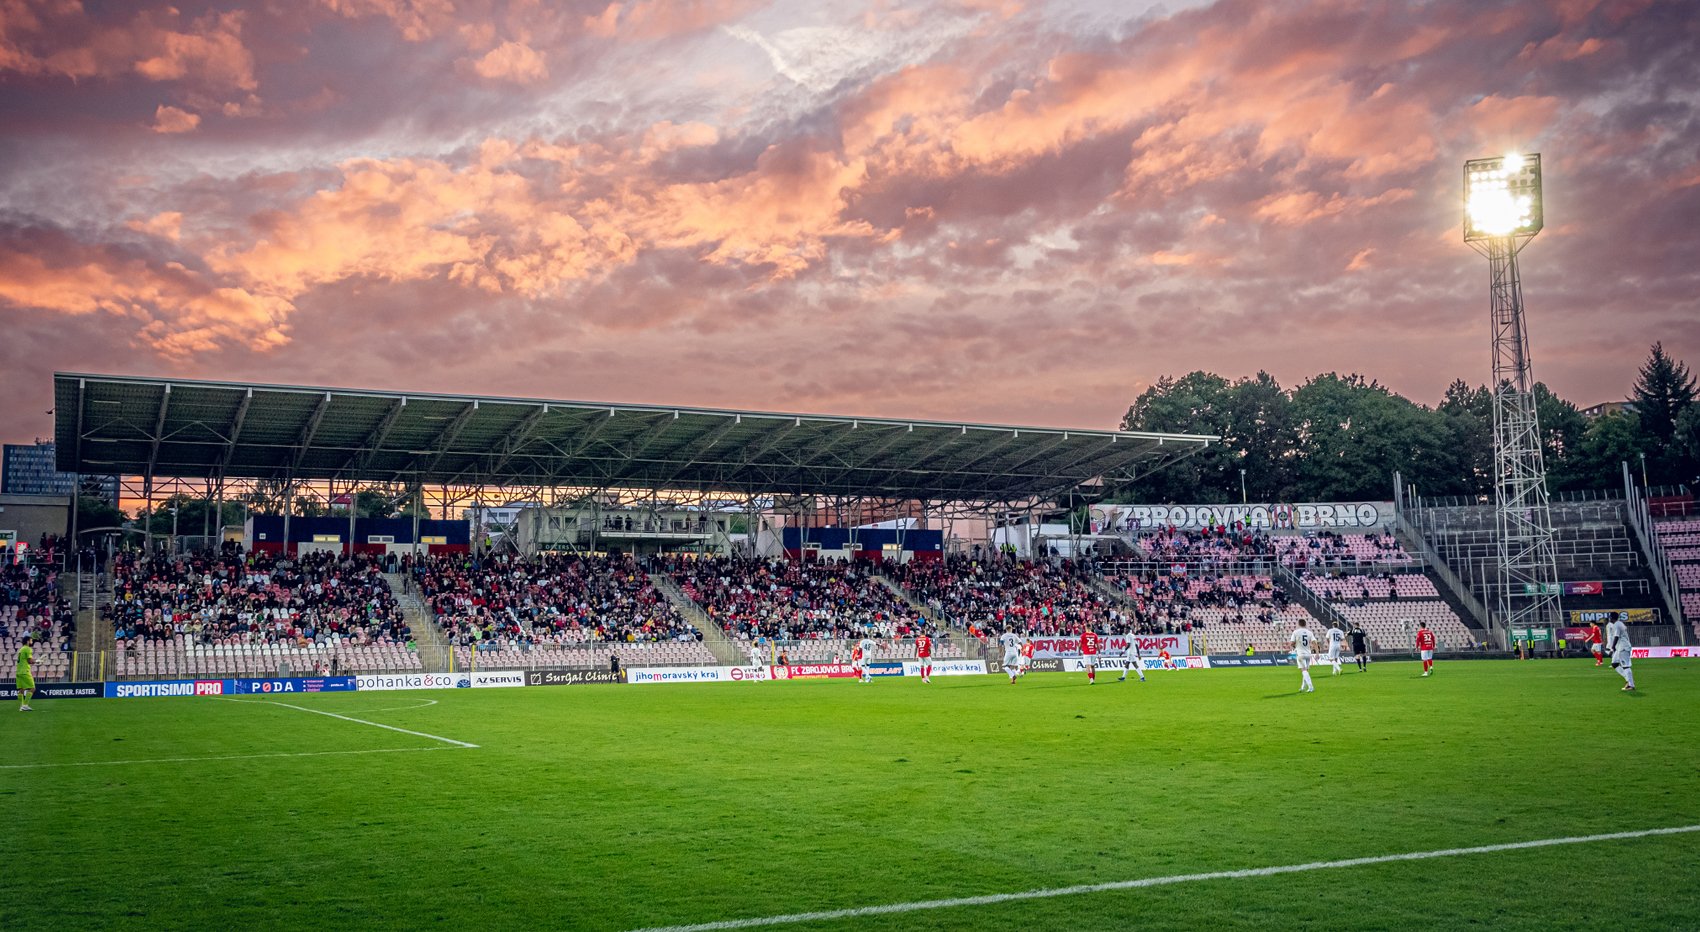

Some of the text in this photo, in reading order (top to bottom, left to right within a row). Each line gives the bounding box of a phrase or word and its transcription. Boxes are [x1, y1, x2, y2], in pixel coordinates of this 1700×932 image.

[1296, 503, 1379, 528] BRNO
[1008, 637, 1014, 648] 3
[1086, 637, 1095, 646] 25
[1301, 634, 1308, 647] 5
[1332, 633, 1340, 642] 15
[791, 666, 801, 675] FC
[801, 665, 840, 675] ZBROJOVKA
[965, 662, 982, 673] kraj
[476, 675, 522, 684] AZ SERVIS
[635, 669, 719, 682] jihomoravský kraj
[117, 682, 222, 697] SPORTISIMO PRO
